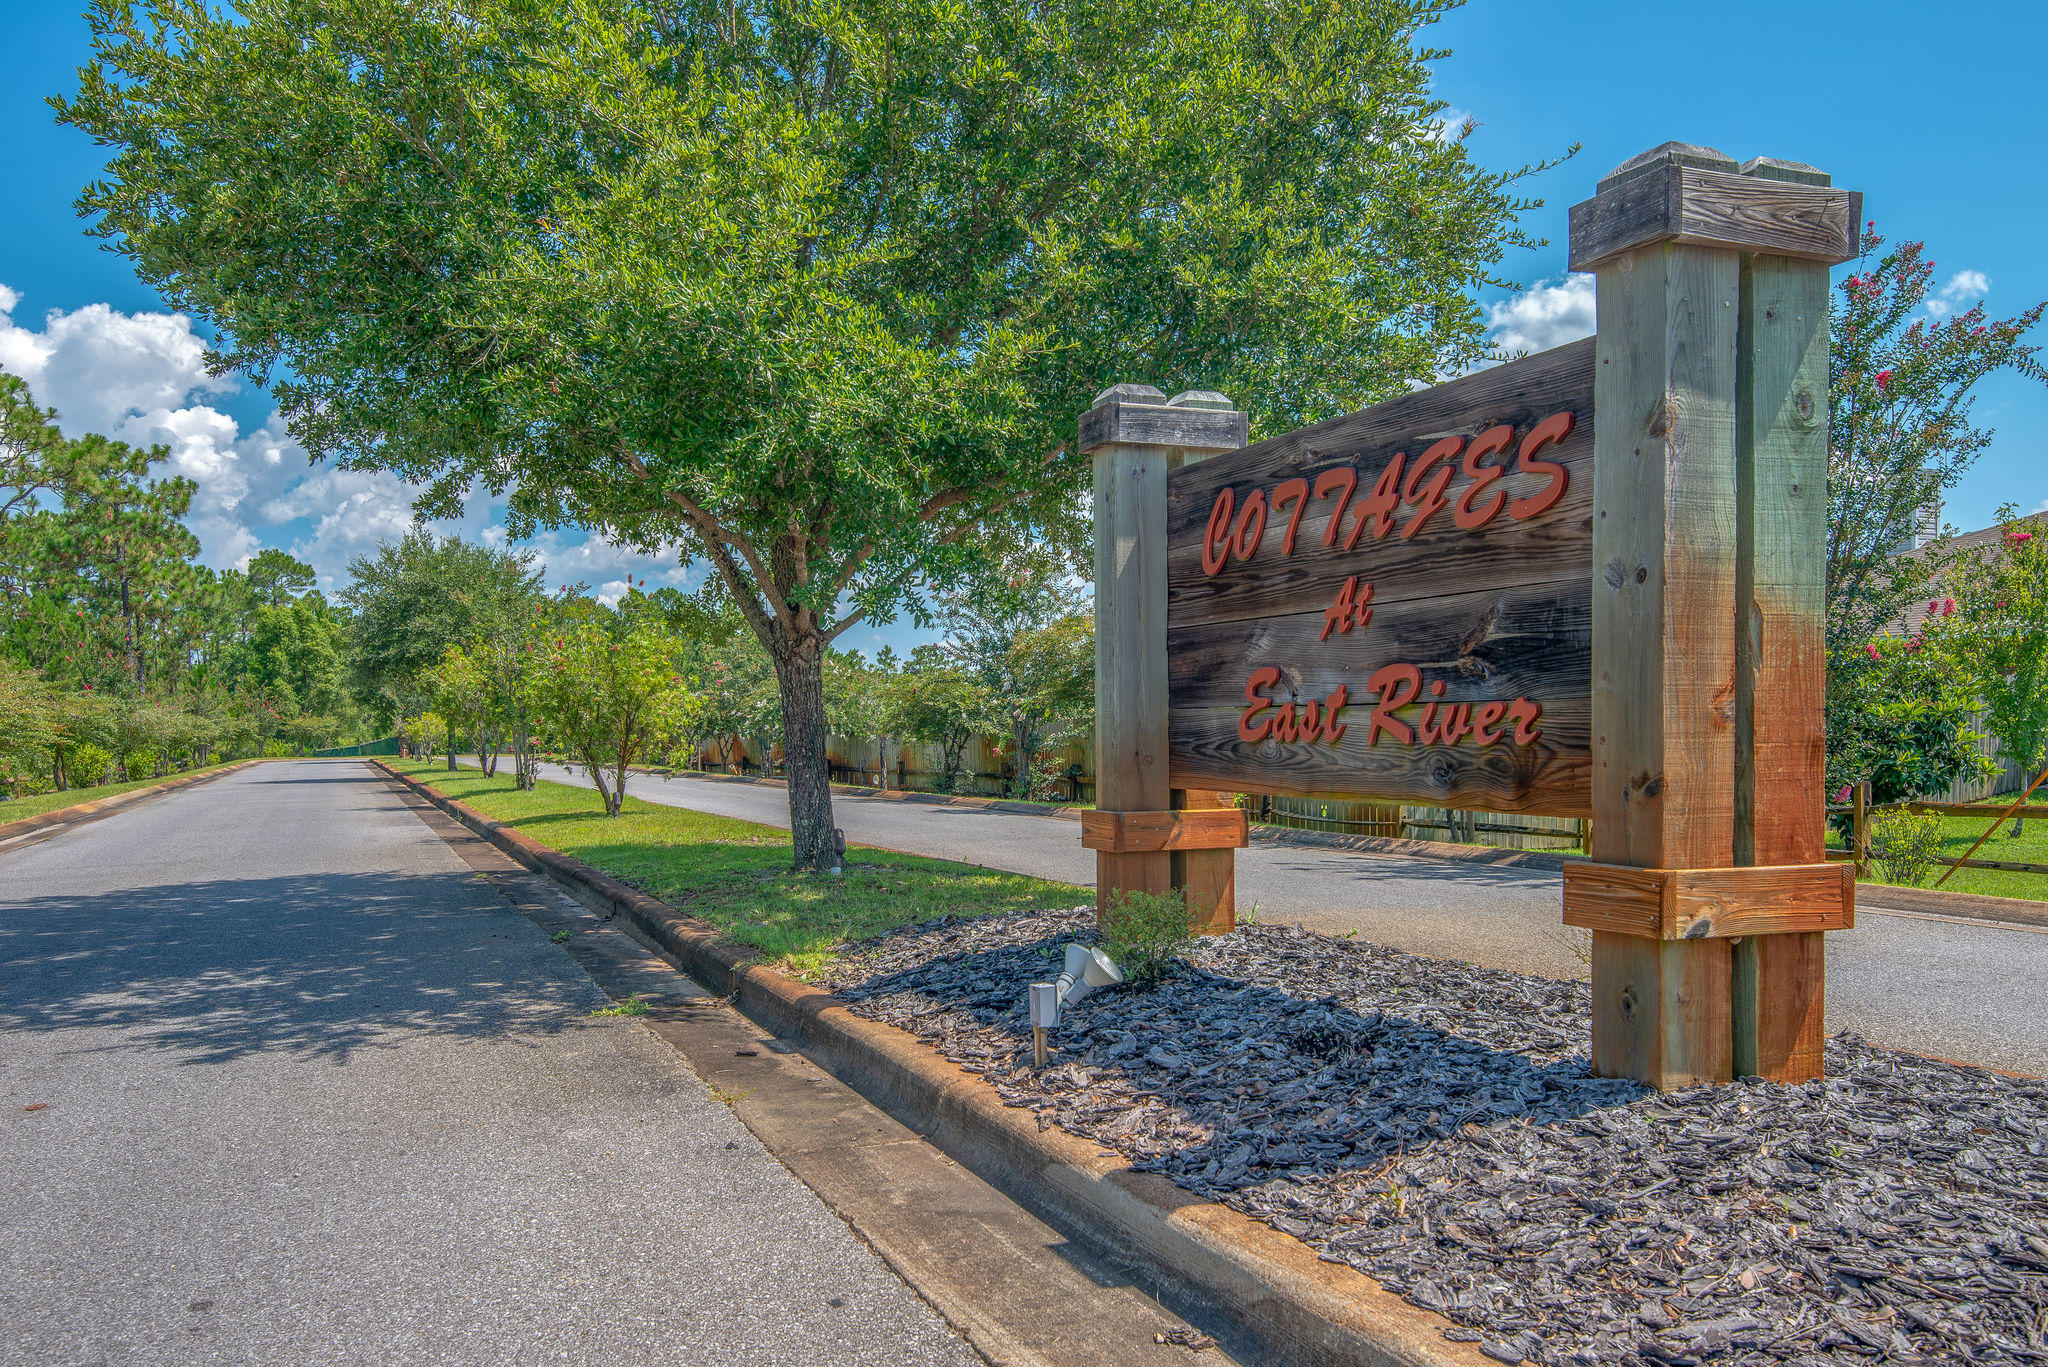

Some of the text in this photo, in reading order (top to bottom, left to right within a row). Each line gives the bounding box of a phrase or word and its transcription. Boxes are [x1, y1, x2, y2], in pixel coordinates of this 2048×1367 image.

[1202, 411, 1575, 576] COTTAGES
[1319, 576, 1374, 642] At
[1238, 662, 1542, 747] East River
